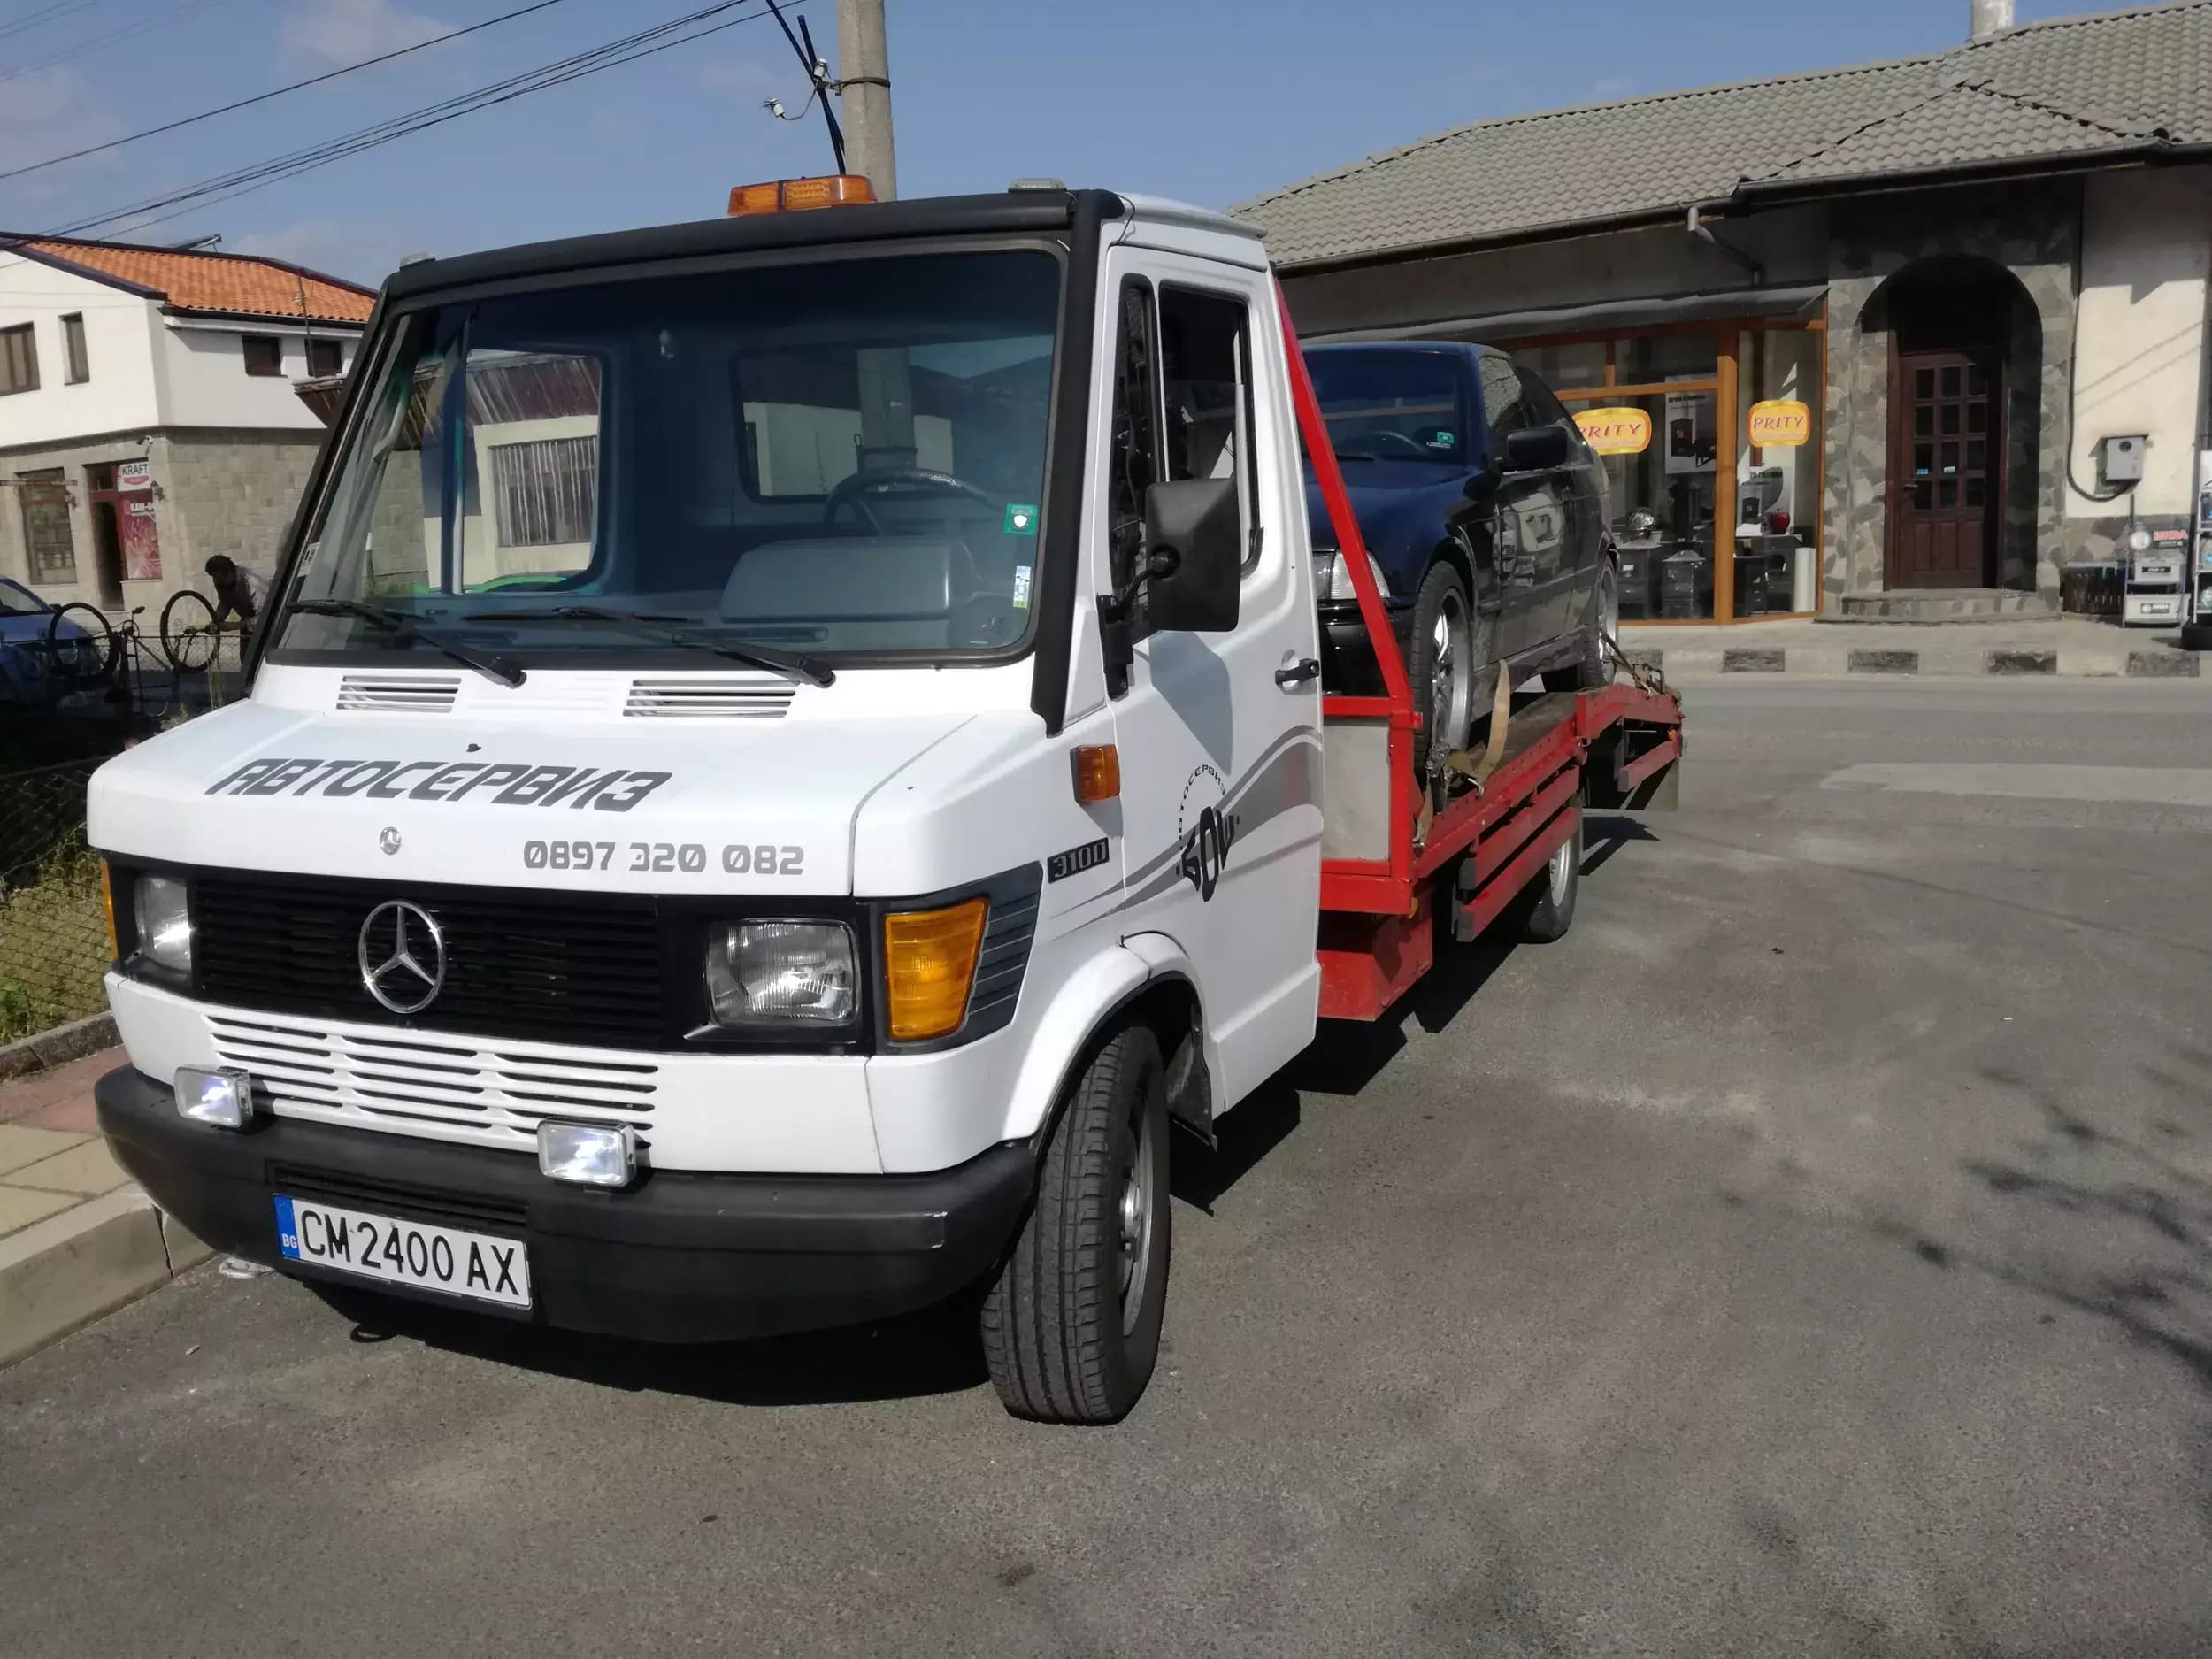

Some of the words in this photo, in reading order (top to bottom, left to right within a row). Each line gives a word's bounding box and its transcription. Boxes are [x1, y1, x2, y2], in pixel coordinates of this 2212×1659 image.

[1753, 416, 1804, 430] PRITY
[122, 464, 148, 476] KRAFT
[204, 758, 672, 812] АВТОСЕРВИЗ
[524, 841, 616, 871] 0897
[629, 842, 706, 872] 320
[722, 844, 804, 876] 082
[281, 1233, 297, 1249] BG
